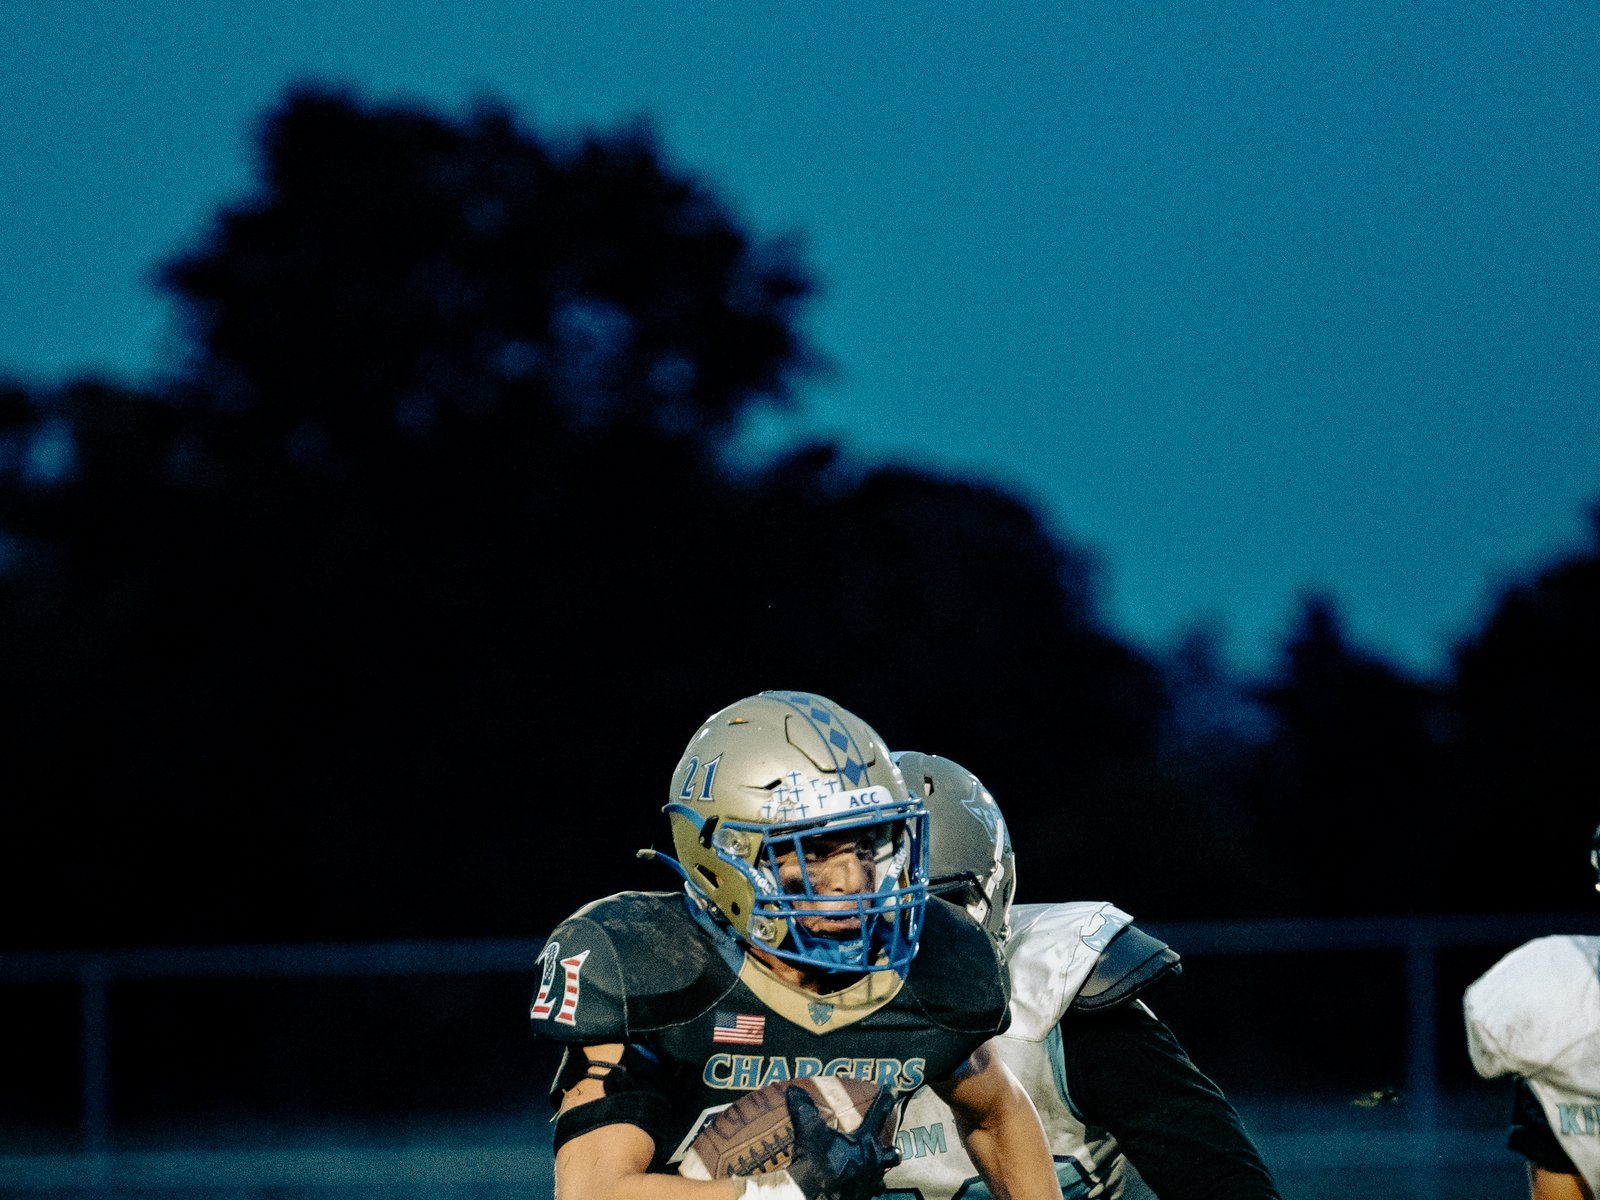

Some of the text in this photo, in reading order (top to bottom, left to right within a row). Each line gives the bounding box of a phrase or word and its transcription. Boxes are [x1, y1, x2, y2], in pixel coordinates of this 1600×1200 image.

[679, 753, 723, 801] 21
[850, 791, 880, 808] ACC
[530, 941, 591, 1026] 21
[702, 1053, 926, 1091] CHARGERS
[1554, 1103, 1600, 1136] KI
